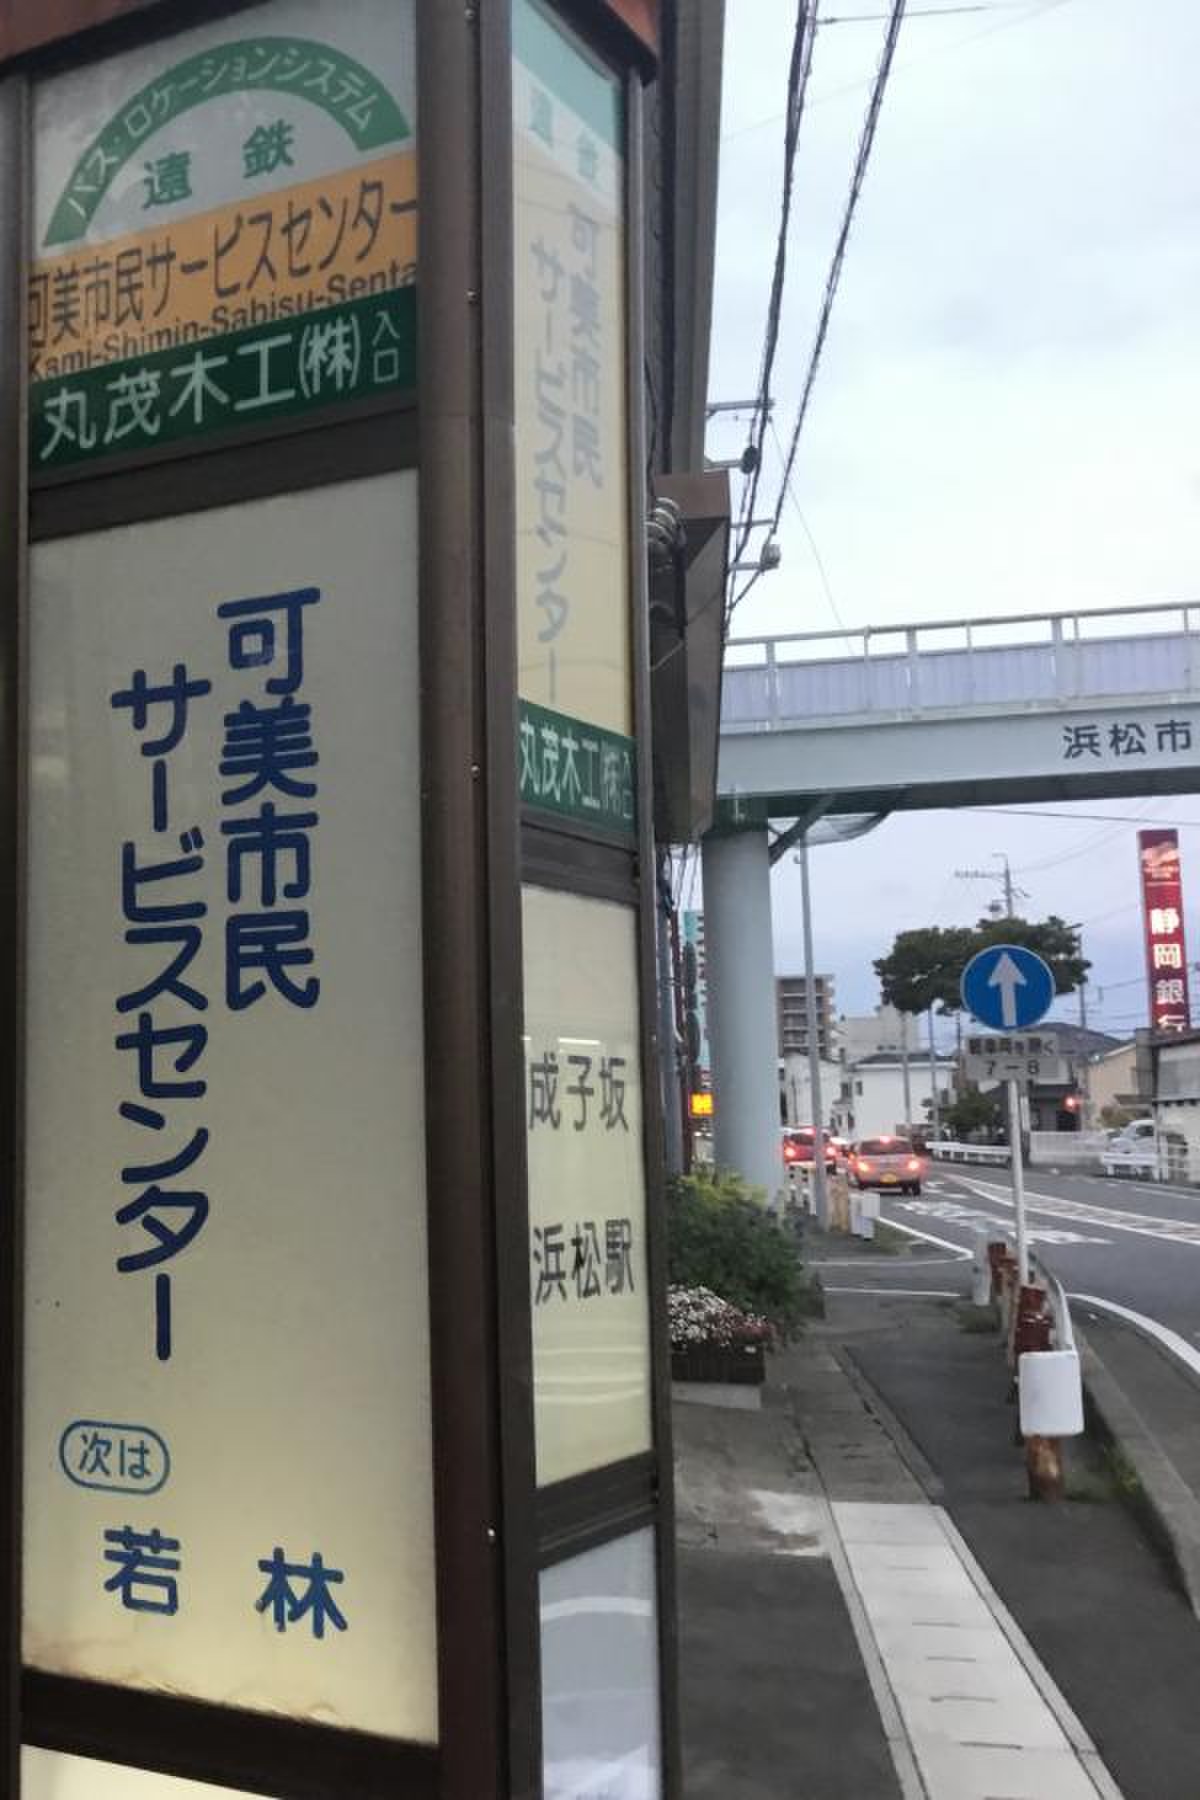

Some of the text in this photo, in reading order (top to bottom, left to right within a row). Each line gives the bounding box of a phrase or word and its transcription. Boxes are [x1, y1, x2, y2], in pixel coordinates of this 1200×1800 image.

[67, 47, 379, 217] バス・ロケーションシステム
[1063, 719, 1192, 759] 浜松市
[216, 585, 321, 1011] 可美市民
[110, 662, 213, 1361] サービスセンター
[529, 1051, 629, 1132] 成子坂
[532, 1217, 635, 1305] 浜松駅
[78, 1431, 152, 1480] 次は
